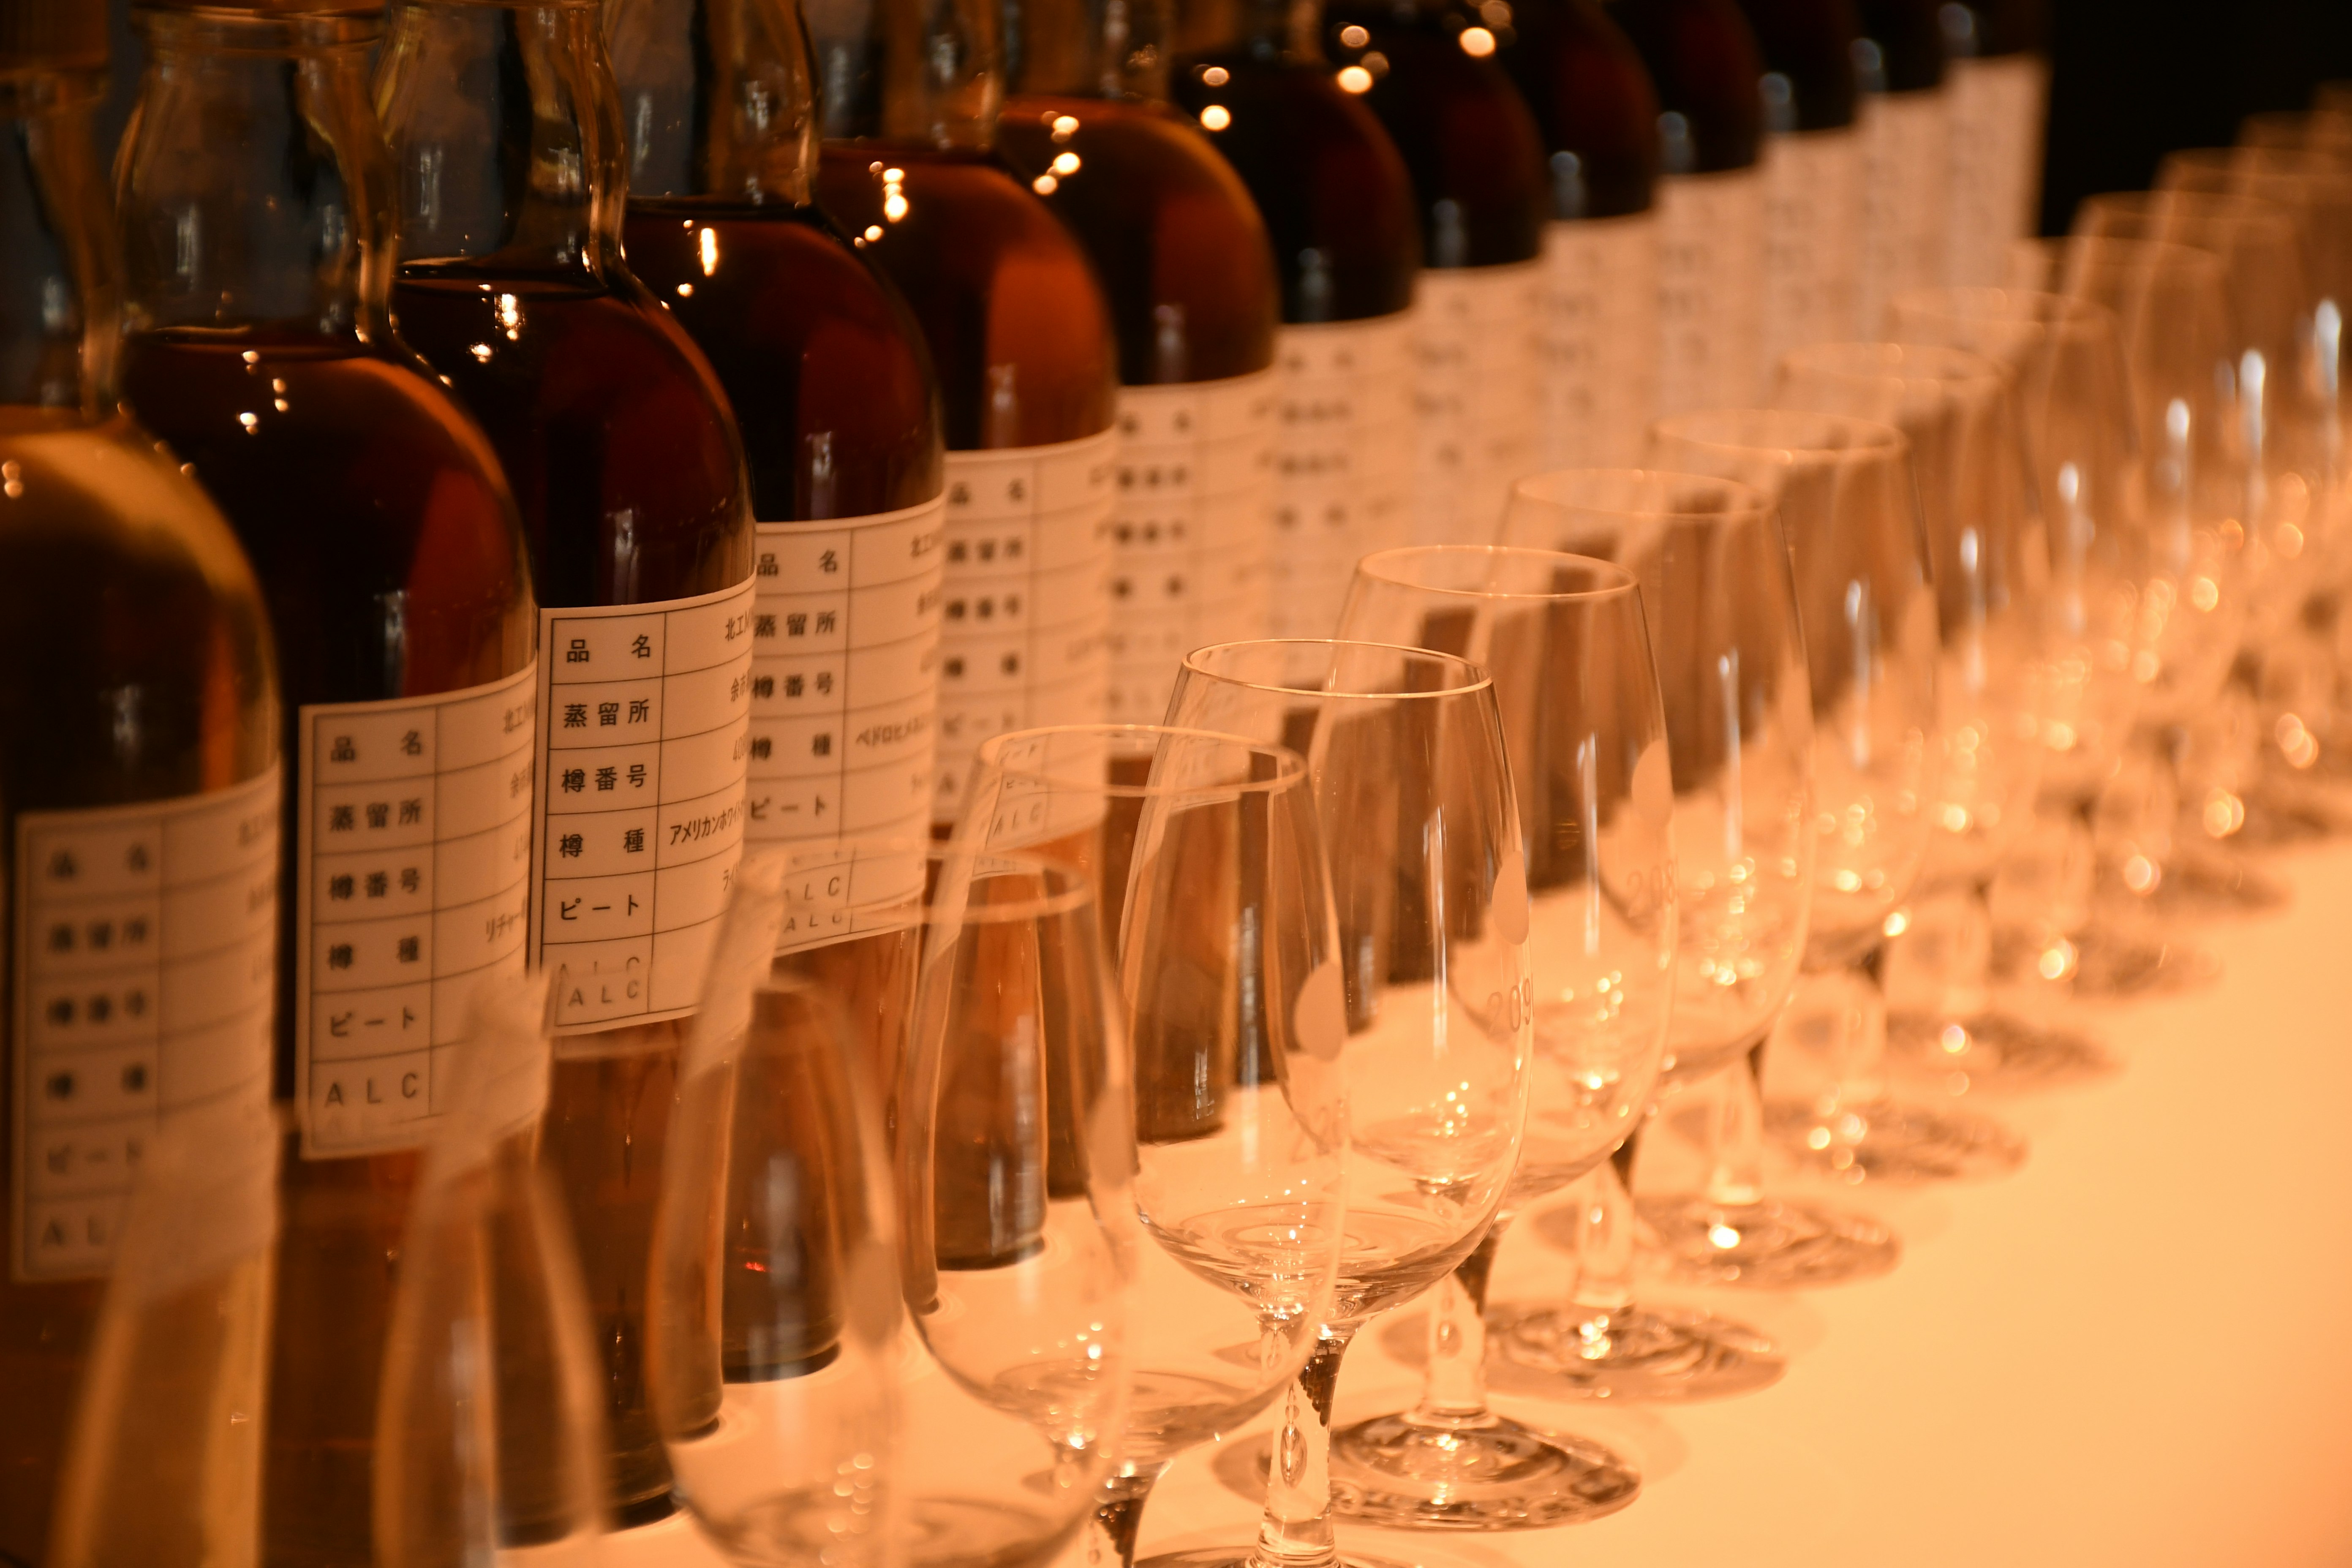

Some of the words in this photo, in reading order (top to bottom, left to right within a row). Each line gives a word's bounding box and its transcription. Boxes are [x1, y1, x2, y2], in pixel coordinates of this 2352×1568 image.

[754, 611, 836, 637] 蒸留所
[567, 634, 651, 663] 品名
[751, 672, 833, 700] 樽番号
[564, 699, 650, 729] 蒸留所
[330, 730, 422, 763] 品名
[561, 764, 647, 793] 樽番号
[330, 798, 421, 831] 蒸留所
[670, 799, 744, 845] アメリカンホワイト
[751, 795, 826, 821] ピート
[559, 828, 645, 858] 樽種
[329, 867, 420, 900] 樽番号
[561, 894, 640, 920] ピート
[330, 1007, 414, 1037] ピート
[324, 1072, 417, 1106] ALC
